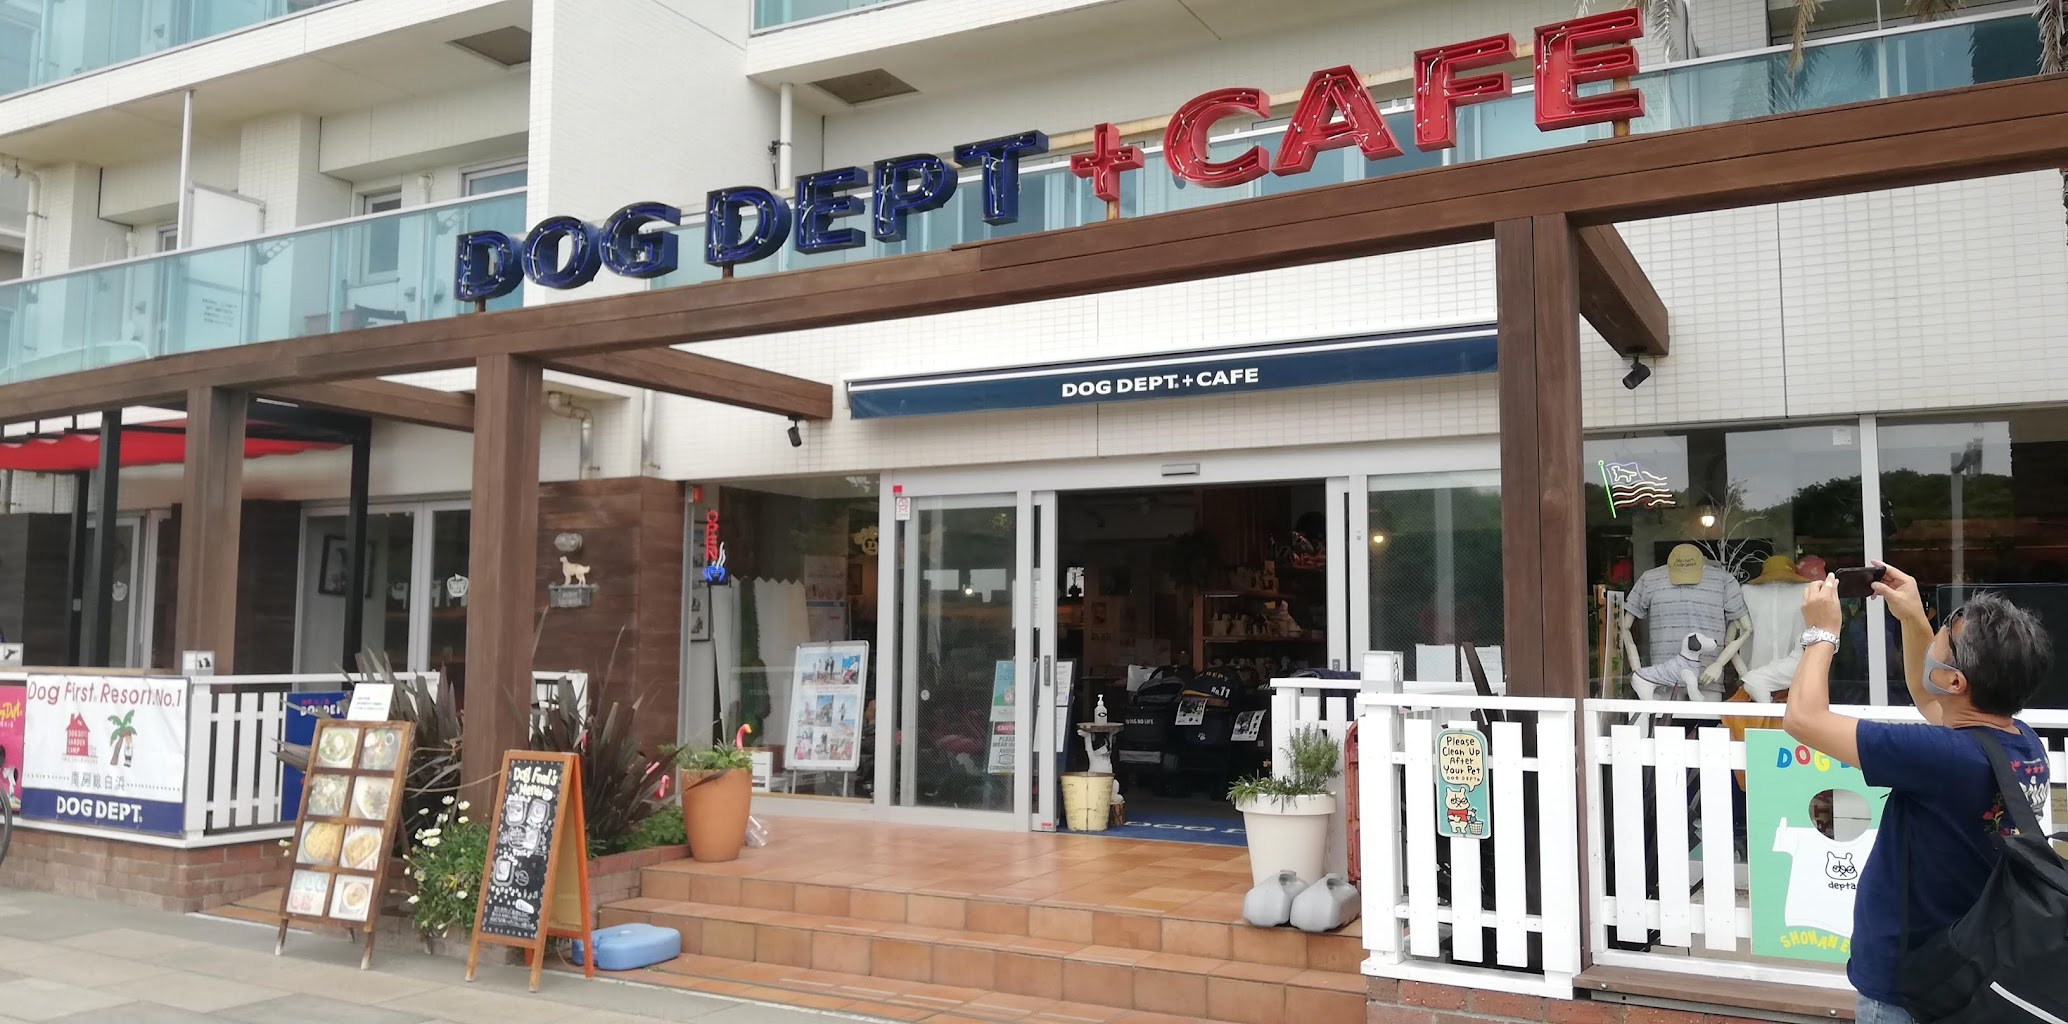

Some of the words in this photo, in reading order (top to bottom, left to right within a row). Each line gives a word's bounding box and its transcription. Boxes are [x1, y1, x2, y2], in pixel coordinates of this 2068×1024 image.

[454, 202, 681, 301] DOG
[705, 130, 1048, 266] DEPT
[1164, 8, 1645, 188] CAFE
[1062, 380, 1111, 397] DOG
[705, 510, 718, 561] OPEN
[28, 681, 60, 705] Dog
[1446, 736, 1475, 746] Please
[1442, 746, 1465, 756] Clean
[1469, 747, 1481, 756] Up
[1449, 756, 1474, 765] After
[1776, 745, 1830, 772] DOG
[1443, 765, 1464, 775] Your
[1467, 765, 1481, 775] Pet
[57, 795, 93, 817] DOG
